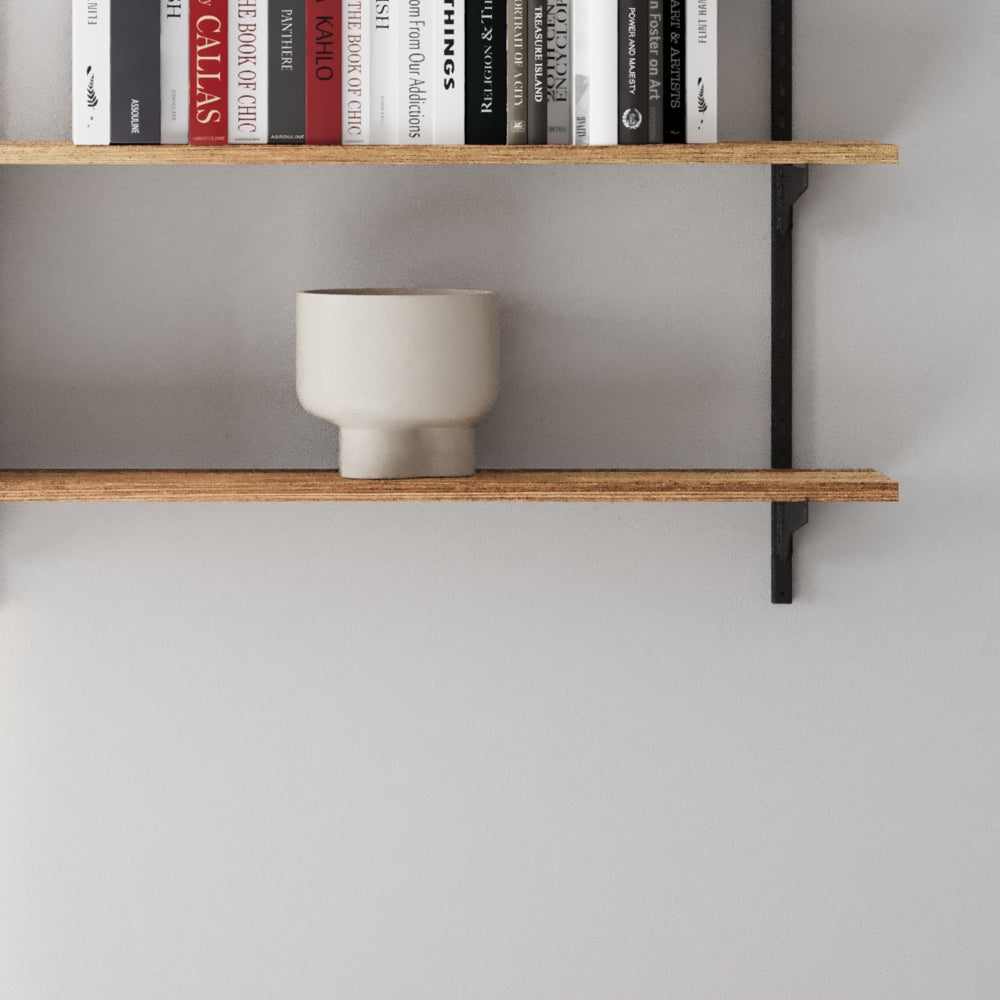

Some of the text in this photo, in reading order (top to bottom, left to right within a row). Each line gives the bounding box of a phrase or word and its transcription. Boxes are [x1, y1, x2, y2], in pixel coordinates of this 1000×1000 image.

[348, 1, 362, 29] THE
[671, 0, 682, 29] ART
[237, 23, 256, 65] BOOK
[281, 9, 292, 70] PANTHERE
[409, 20, 425, 49] From
[481, 25, 493, 41] &
[650, 13, 661, 56] Foster
[671, 32, 682, 44] &
[698, 18, 707, 43] FLINT
[316, 17, 333, 81] KAHLO
[348, 33, 362, 73] BOOK
[514, 52, 522, 68] OF
[196, 15, 221, 124] CALLAS
[409, 54, 425, 74] Our
[650, 59, 661, 76] on
[671, 47, 682, 108] ARTISTS
[237, 70, 256, 90] OF
[348, 75, 362, 97] OF
[514, 80, 522, 107] CITY
[650, 79, 661, 100] Art
[237, 93, 256, 132] CHIC
[348, 99, 362, 135] CHIC
[409, 78, 426, 138] Addictions
